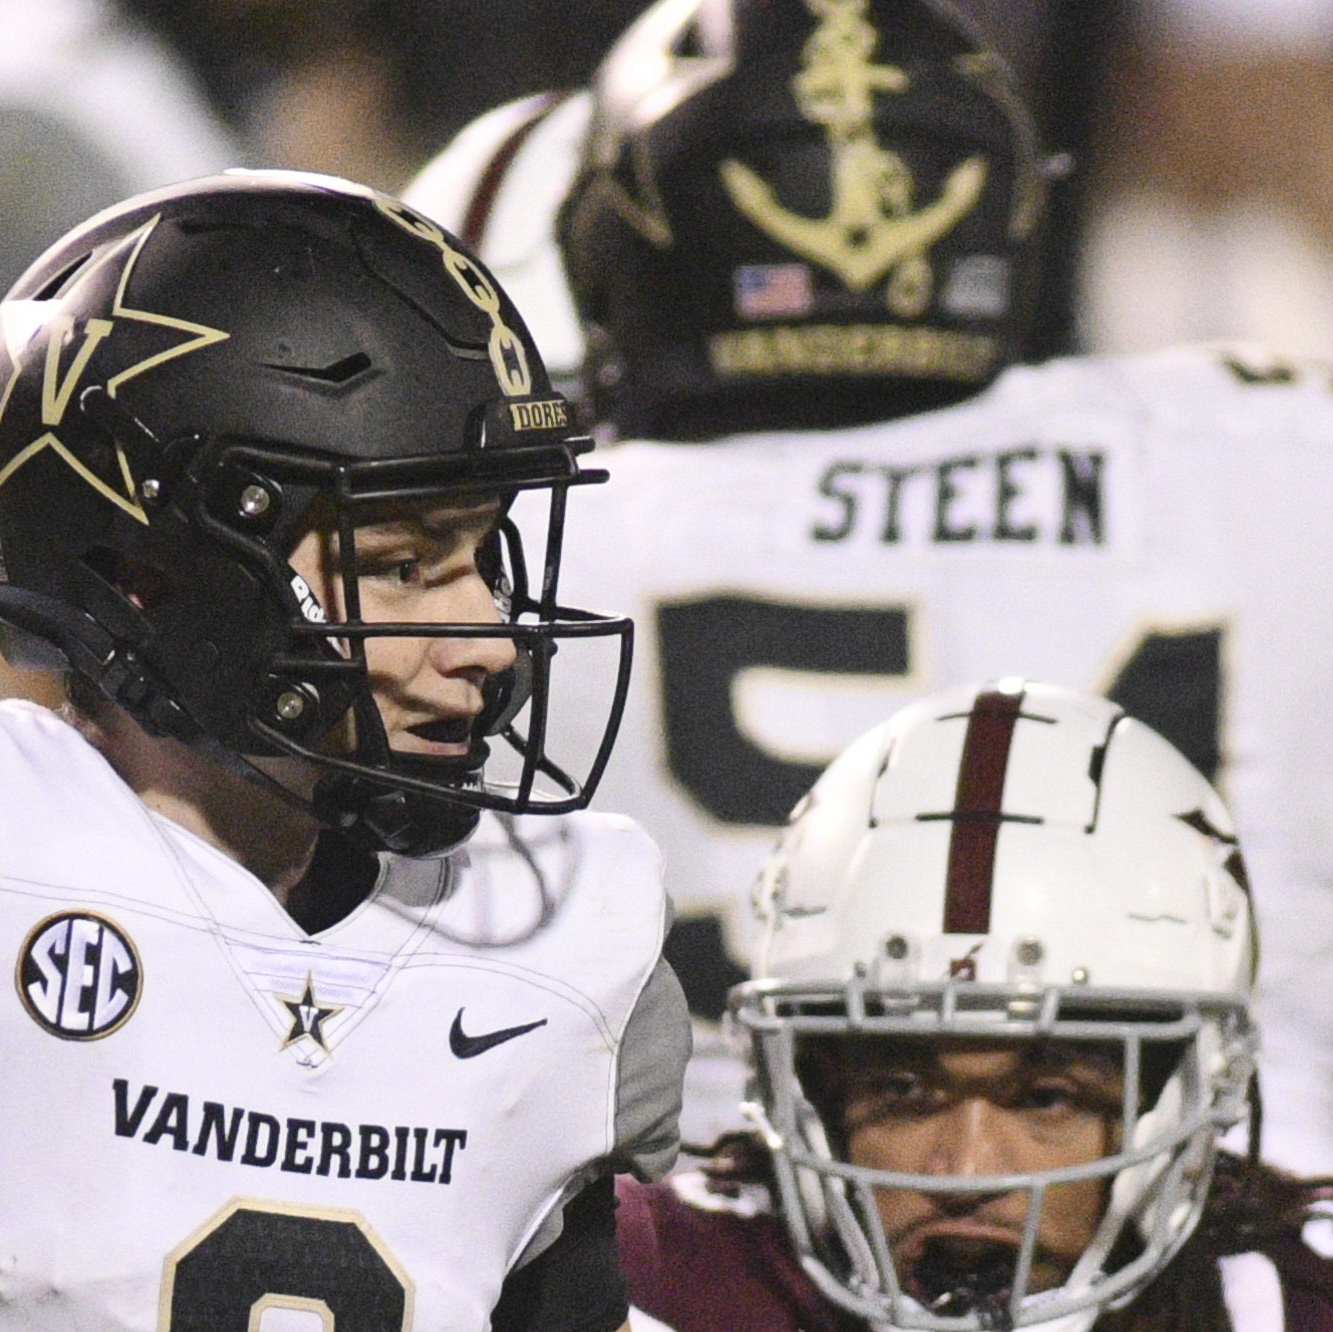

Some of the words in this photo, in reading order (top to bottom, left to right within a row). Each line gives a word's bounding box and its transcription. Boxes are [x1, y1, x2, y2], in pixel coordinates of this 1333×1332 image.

[809, 447, 1106, 545] STEEN
[25, 917, 134, 1032] SEC
[298, 1004, 320, 1034] V
[112, 1077, 469, 1186] VANDERBILT
